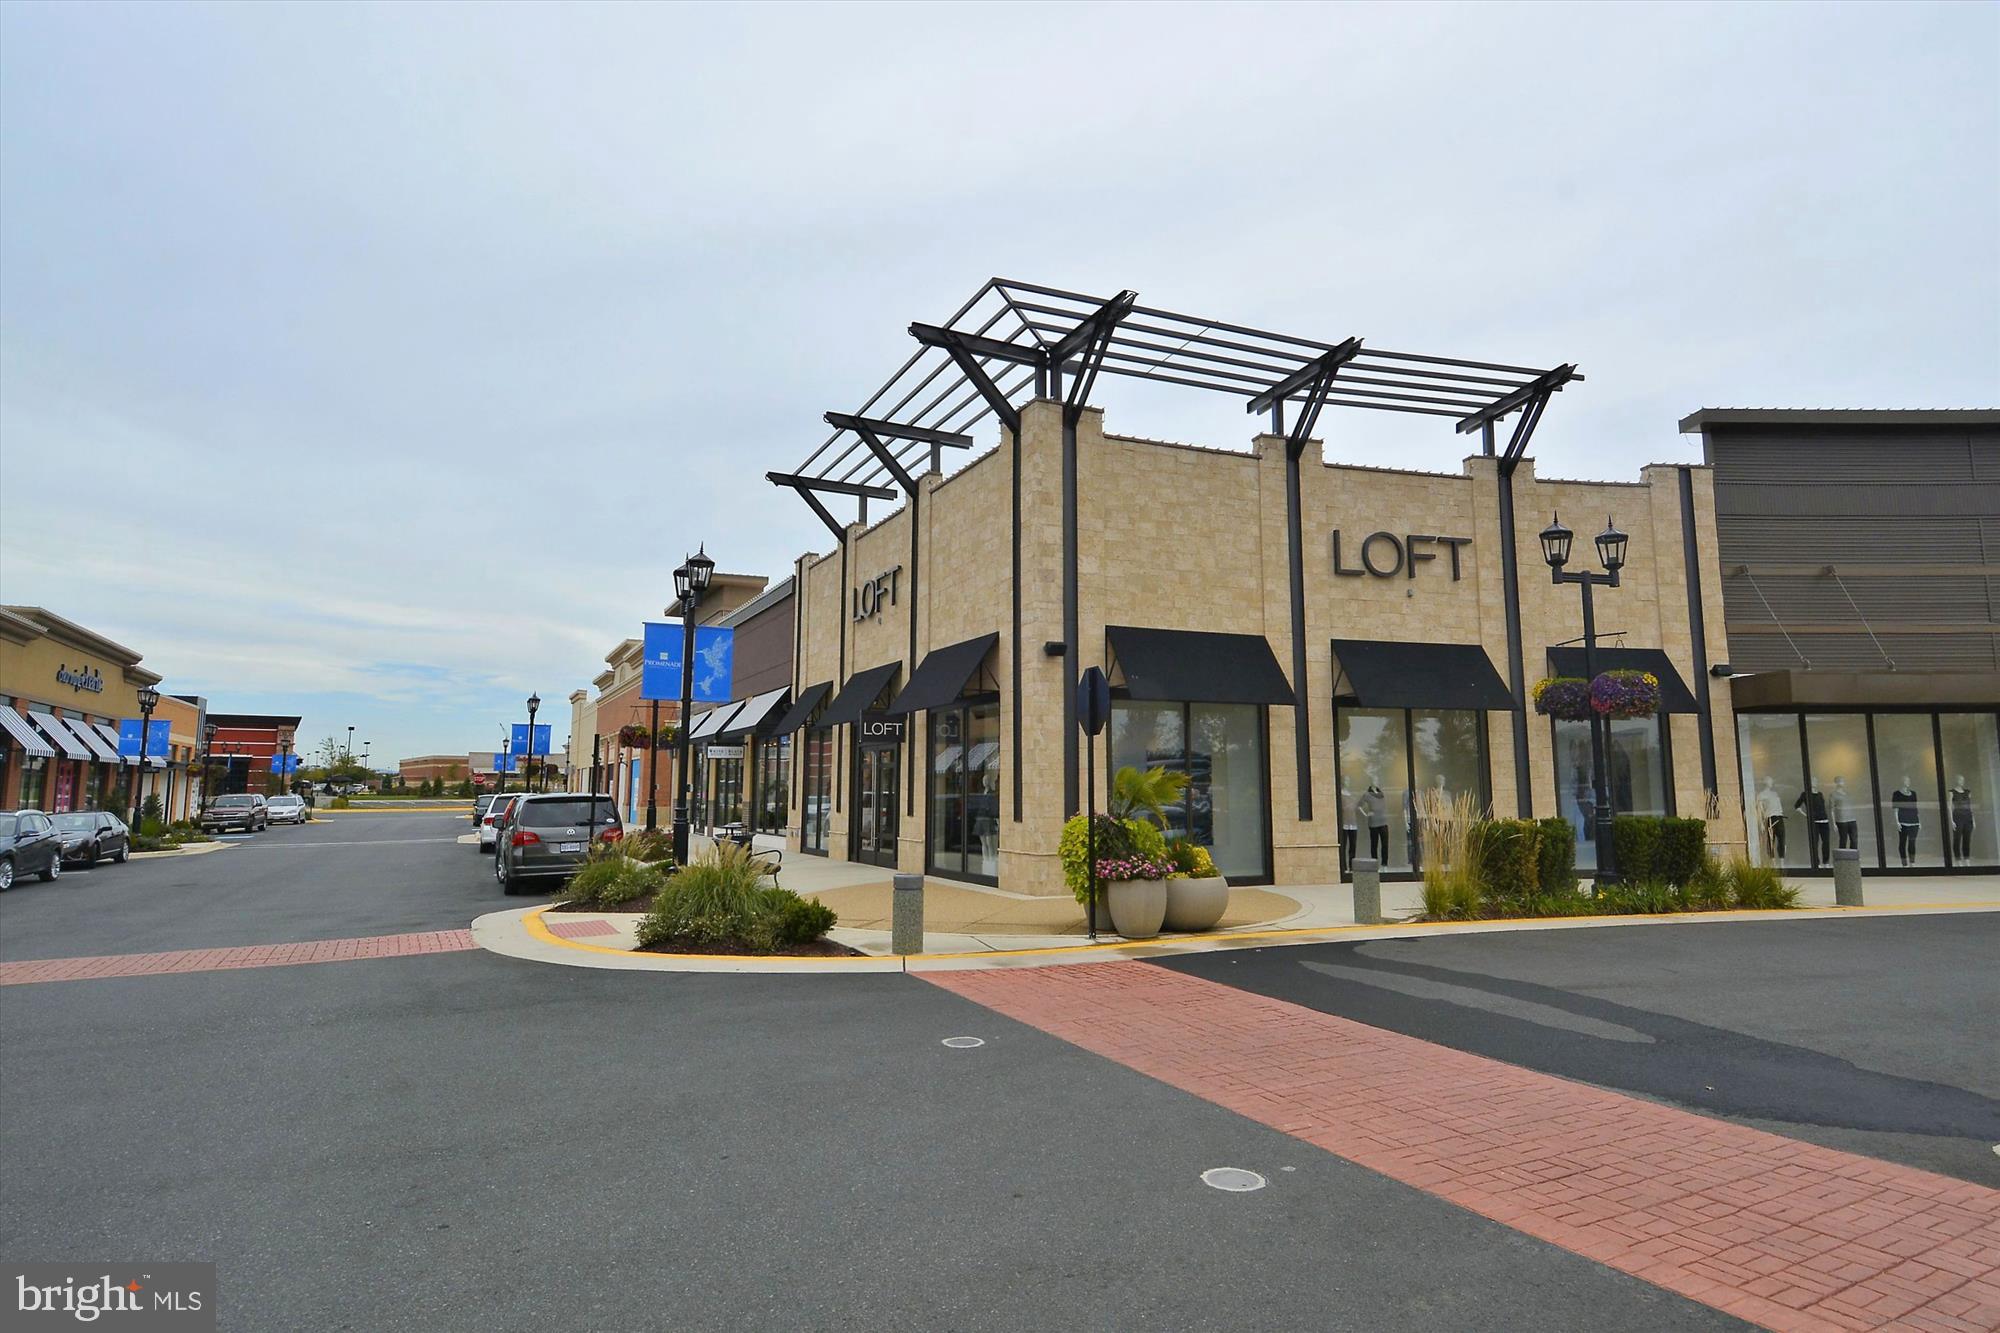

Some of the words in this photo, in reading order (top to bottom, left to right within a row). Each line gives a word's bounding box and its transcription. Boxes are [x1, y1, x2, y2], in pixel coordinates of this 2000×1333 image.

[1333, 529, 1472, 581] LOFT
[853, 565, 902, 622] LOFT
[863, 722, 903, 736] LOFT
